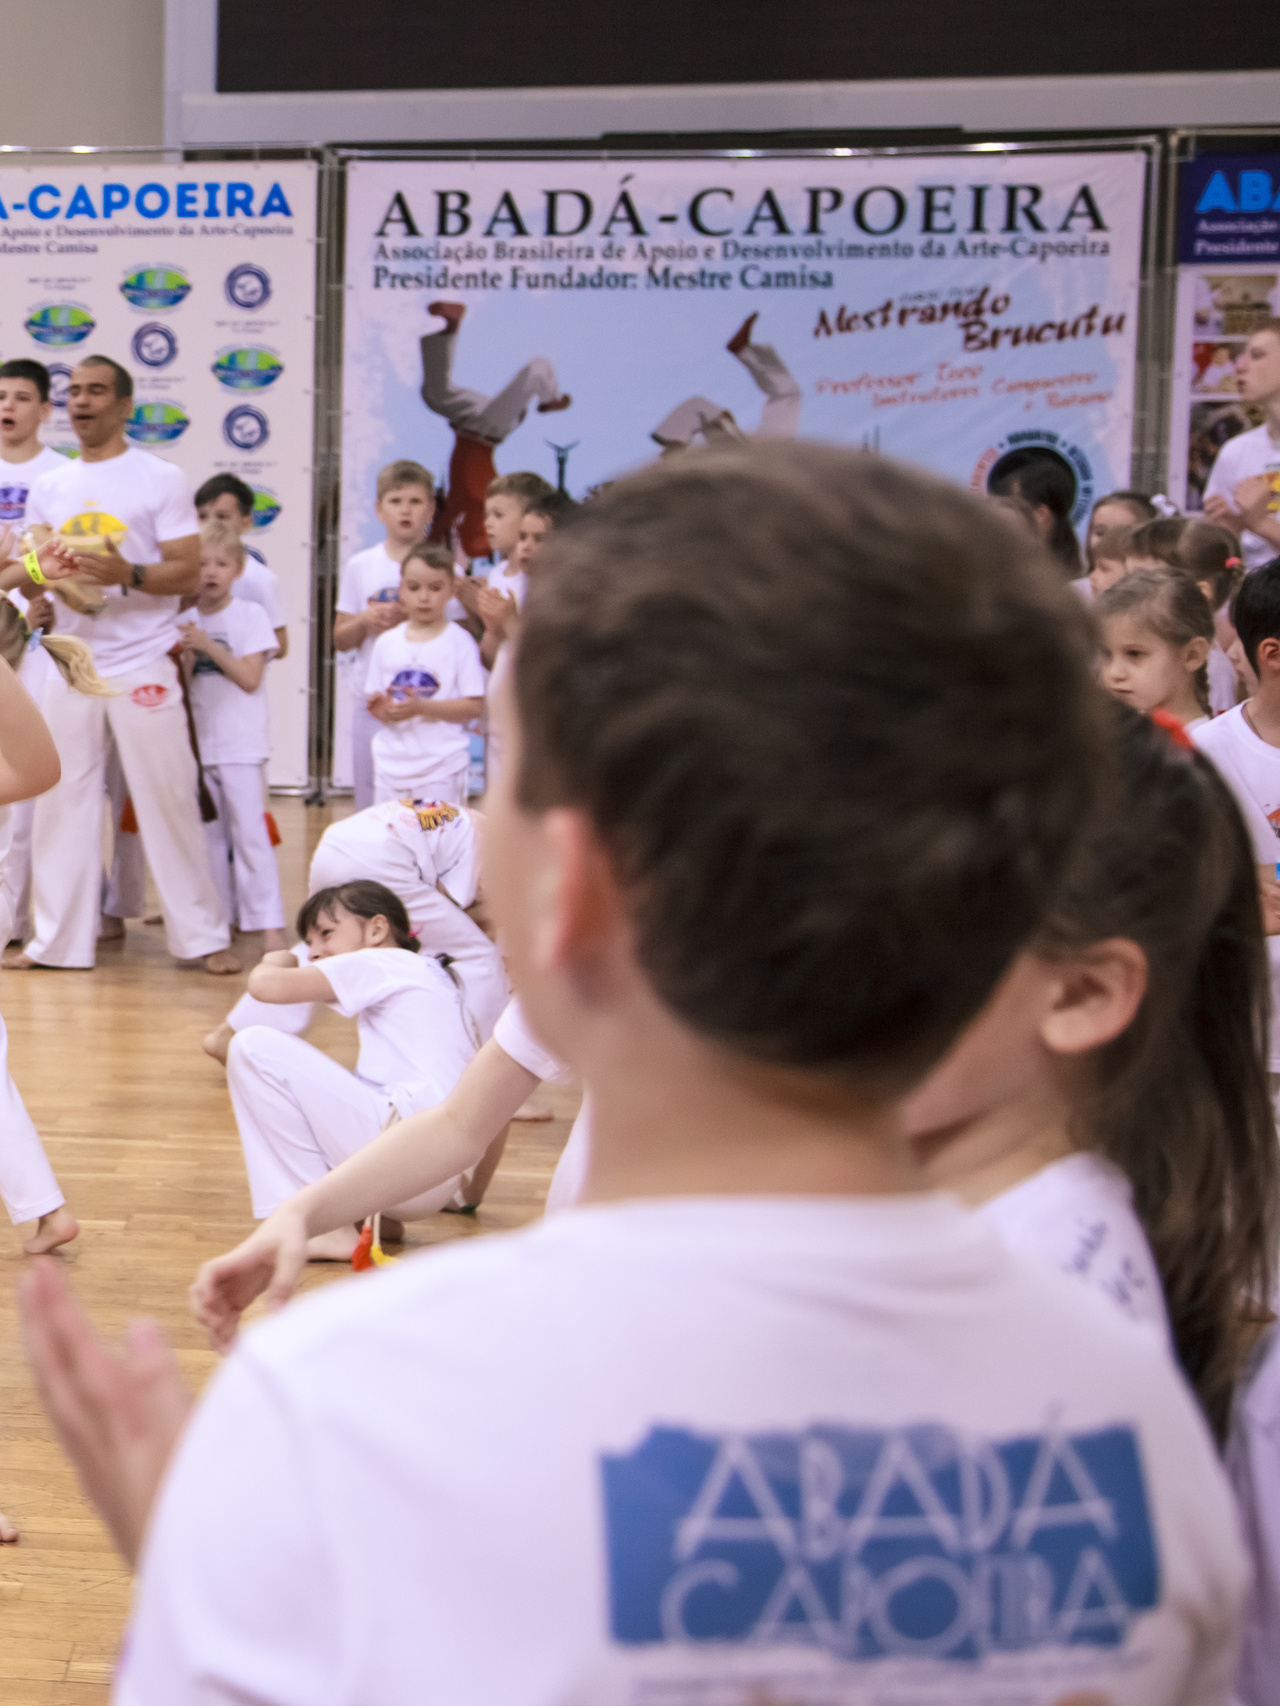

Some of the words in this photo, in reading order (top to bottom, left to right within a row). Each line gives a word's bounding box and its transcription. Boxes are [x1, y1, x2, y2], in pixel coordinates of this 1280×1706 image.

[374, 174, 1110, 238] ABADÁ-CAPOEIRA
[1197, 169, 1280, 213] AB
[375, 242, 488, 265] Associação
[493, 241, 595, 261] Brasileira
[602, 241, 623, 261] de
[634, 241, 698, 265] Apoio
[704, 246, 714, 261] e
[722, 238, 914, 260] Desenvolvimento
[920, 238, 946, 259] da
[954, 236, 1111, 263] Arte-Capoeira
[373, 266, 503, 290] Presidente
[510, 266, 638, 289] Fundador:
[646, 265, 731, 289] Mestre
[739, 263, 834, 289] Camisa
[813, 285, 1012, 339] Mestrando
[958, 303, 1126, 353] Brucutu
